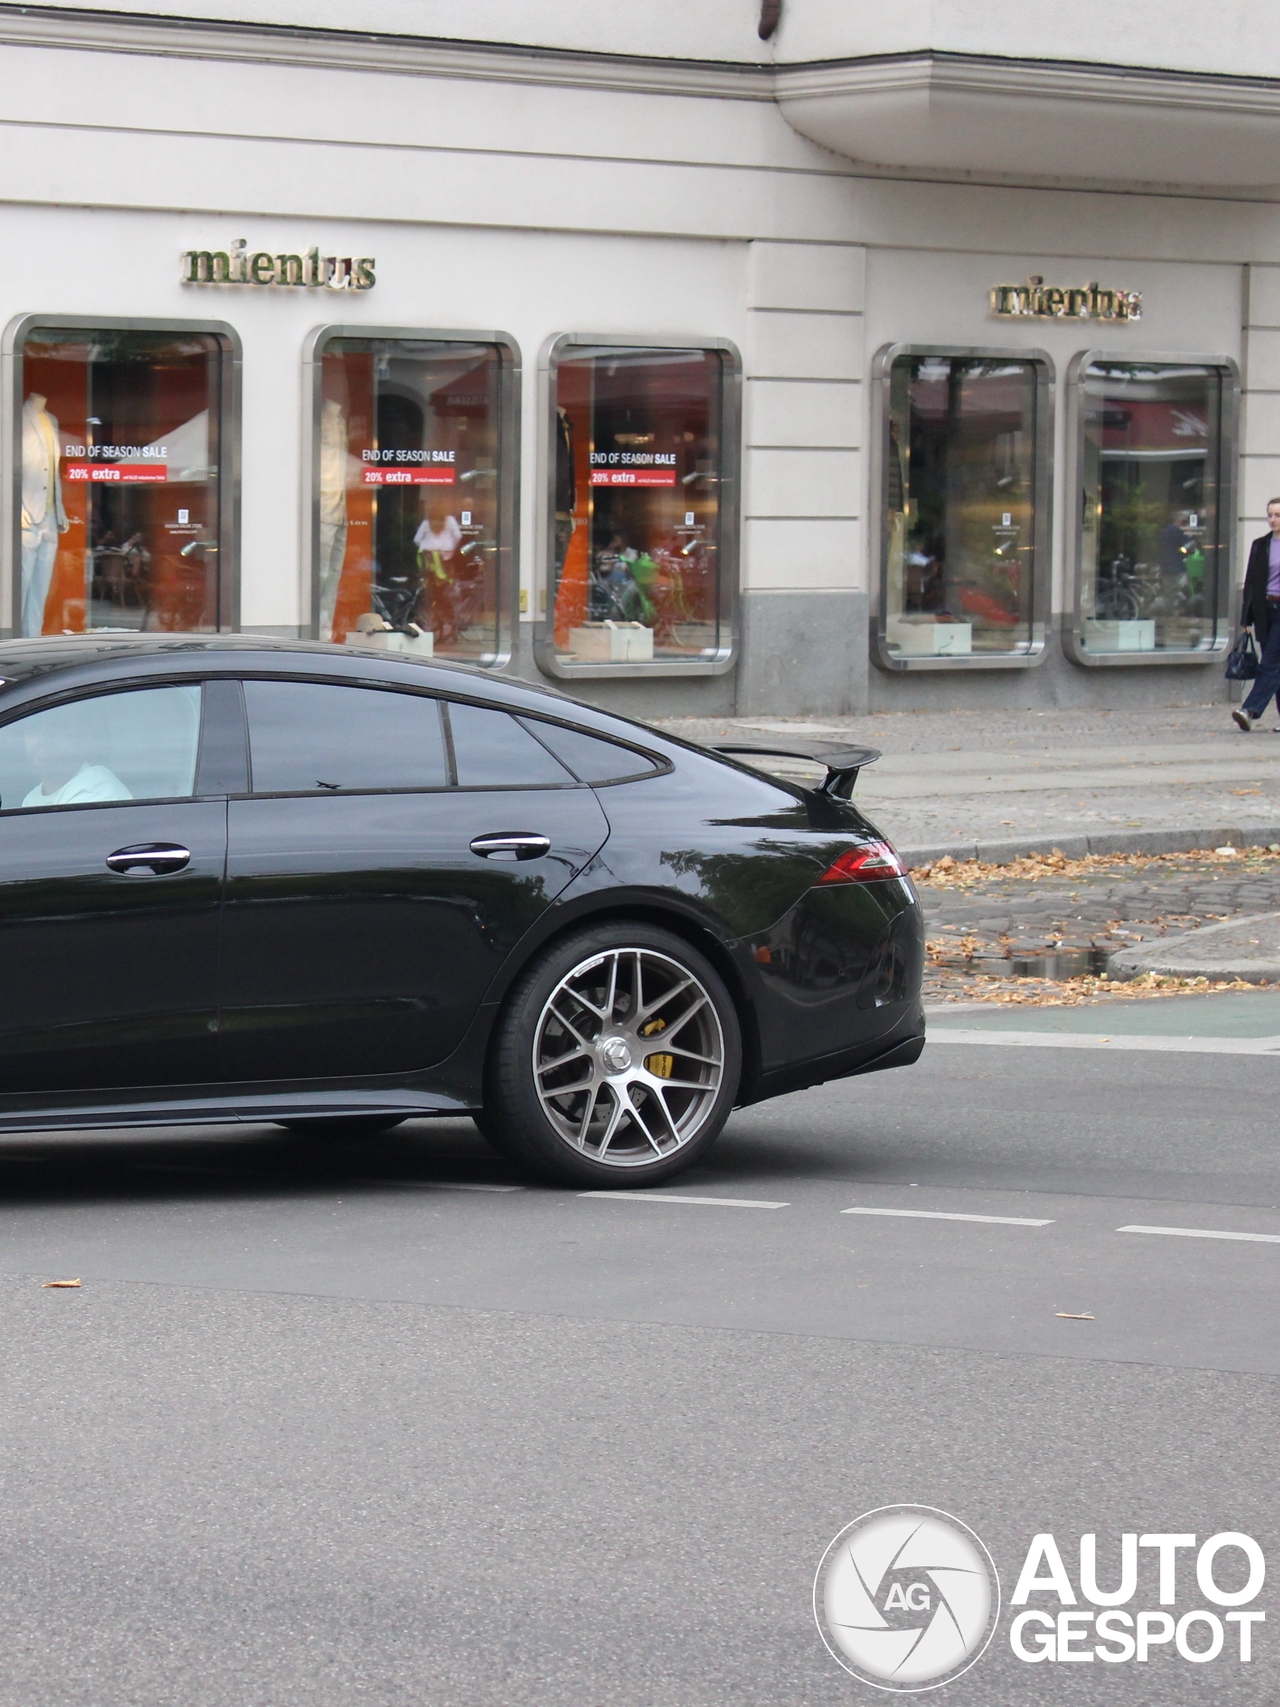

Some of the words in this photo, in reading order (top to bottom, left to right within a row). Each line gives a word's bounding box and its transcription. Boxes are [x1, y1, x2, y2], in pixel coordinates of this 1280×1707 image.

[181, 238, 376, 290] mientus
[990, 275, 1143, 321] mientus
[65, 445, 86, 457] END
[87, 445, 101, 457] OF
[102, 445, 140, 458] SEASON
[142, 446, 167, 458] SALE
[362, 449, 380, 461] END
[382, 449, 395, 461] OF
[396, 449, 431, 461] SEASON
[432, 450, 455, 462] SALE
[590, 452, 607, 464] END
[608, 452, 620, 464] OF
[621, 453, 653, 464] SEASON
[654, 453, 676, 465] SALE
[69, 468, 88, 479] 20%
[92, 468, 120, 479] extra
[365, 472, 383, 482] 20%
[385, 471, 411, 482] extra
[592, 473, 608, 483] 20%
[611, 472, 635, 483] extra
